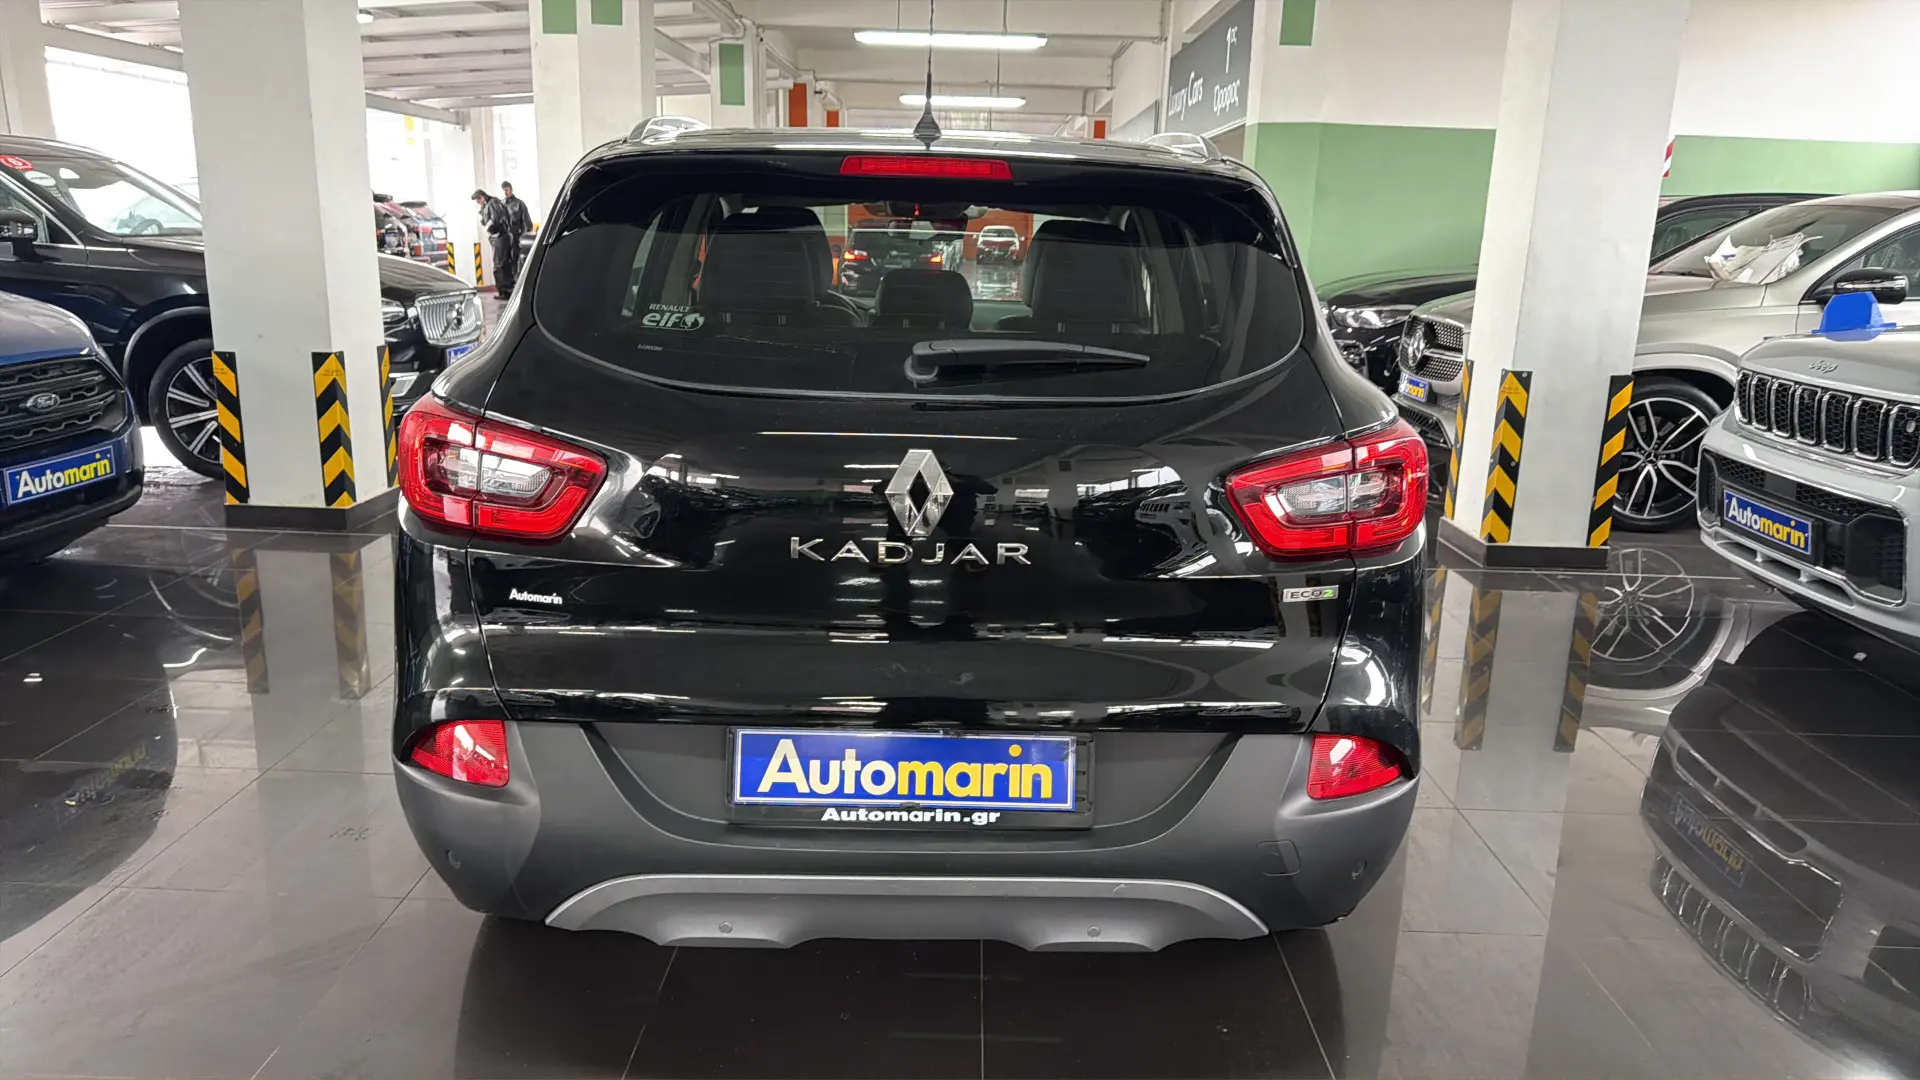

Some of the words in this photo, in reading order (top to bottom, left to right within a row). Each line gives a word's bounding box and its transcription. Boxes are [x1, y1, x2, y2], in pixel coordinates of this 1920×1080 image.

[1187, 71, 1204, 107] Cars
[649, 303, 690, 312] RENAULT
[642, 312, 683, 328] elf
[1808, 360, 1838, 373] Jeep
[37, 396, 55, 408] Ford
[17, 453, 111, 498] Automarin
[1728, 497, 1806, 549] Automarin
[790, 536, 1032, 565] KADJAR
[509, 587, 563, 605] Automarin
[1290, 589, 1334, 599] ECO2
[756, 738, 1053, 799] Automarin
[820, 807, 1001, 826] Automarin.gr
